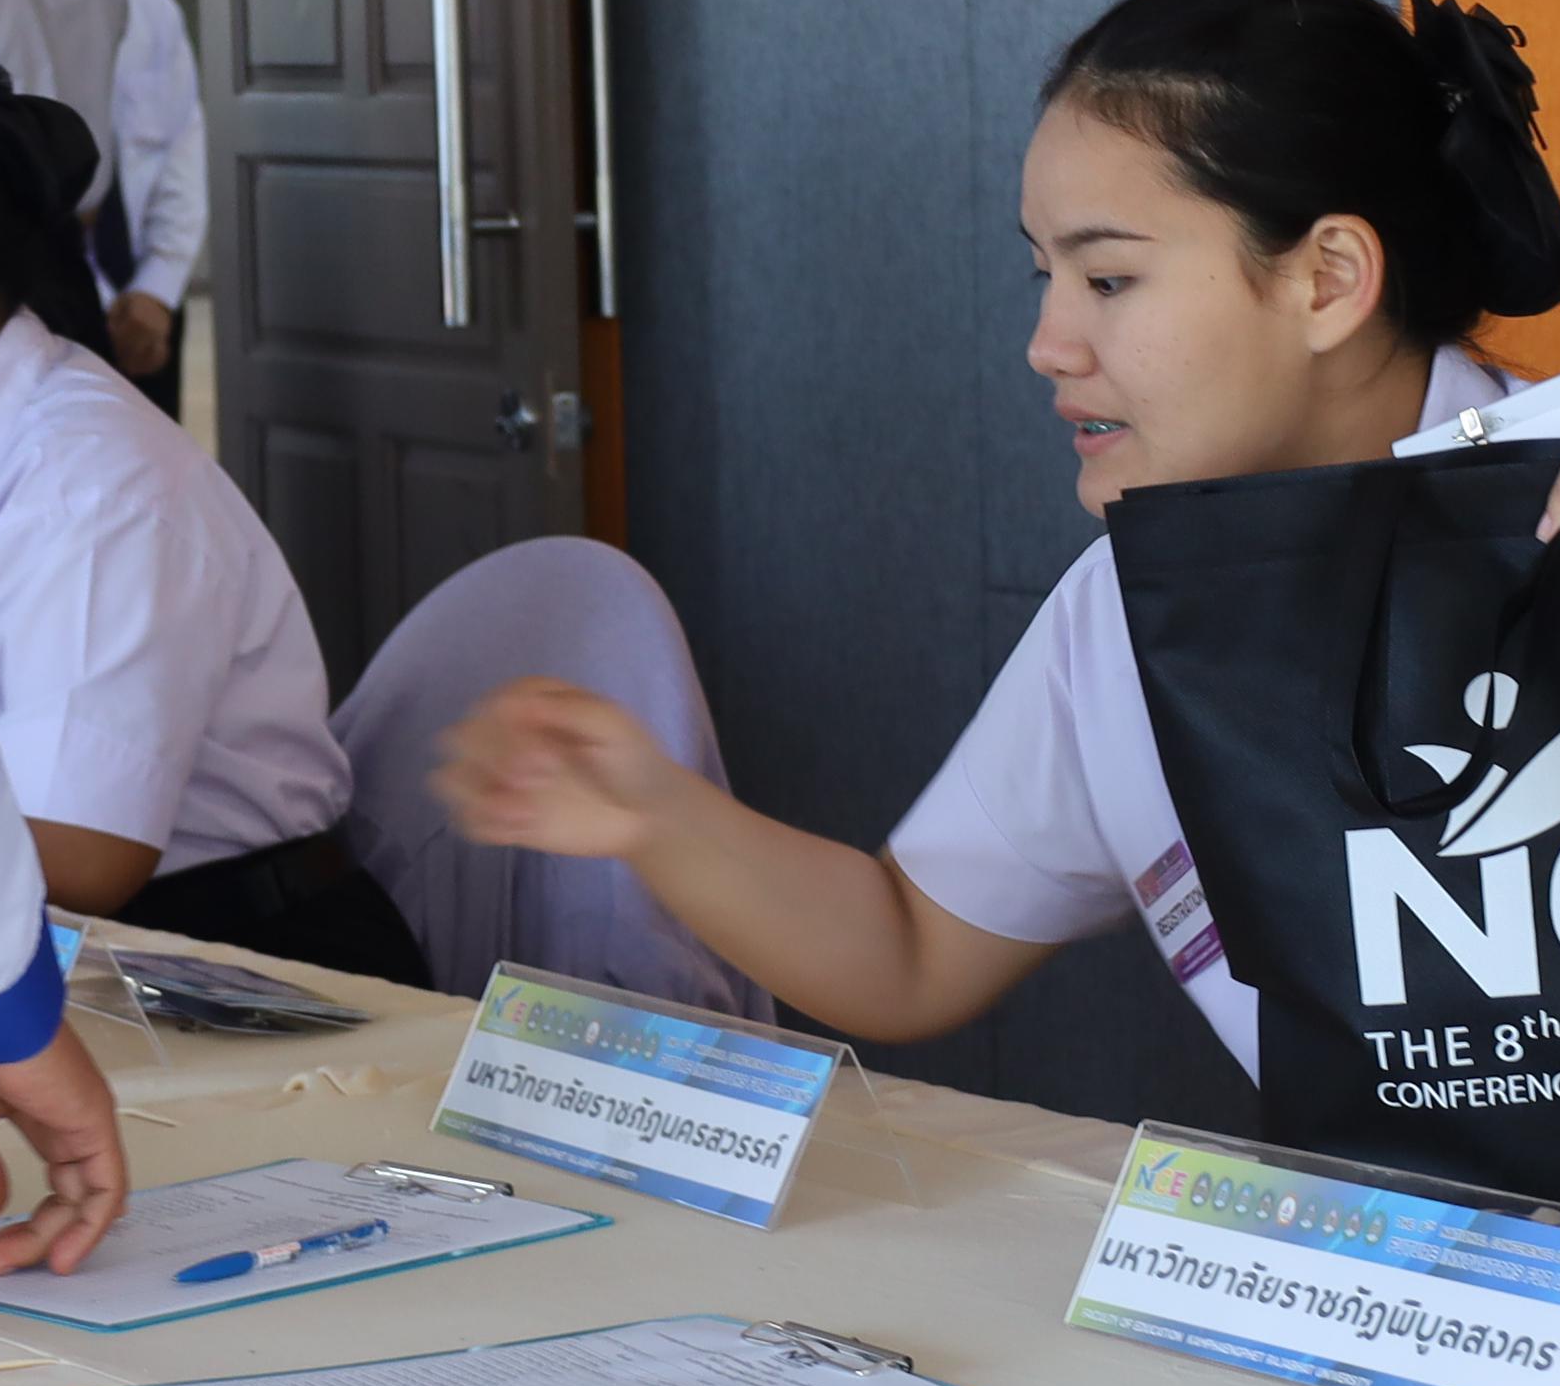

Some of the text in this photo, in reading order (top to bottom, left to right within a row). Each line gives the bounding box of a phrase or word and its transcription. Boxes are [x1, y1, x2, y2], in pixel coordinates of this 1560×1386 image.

[1364, 1025, 1474, 1070] THE
[465, 1058, 789, 1169] มหาวิทยาลัยราชภัฏนครสวรรค์
